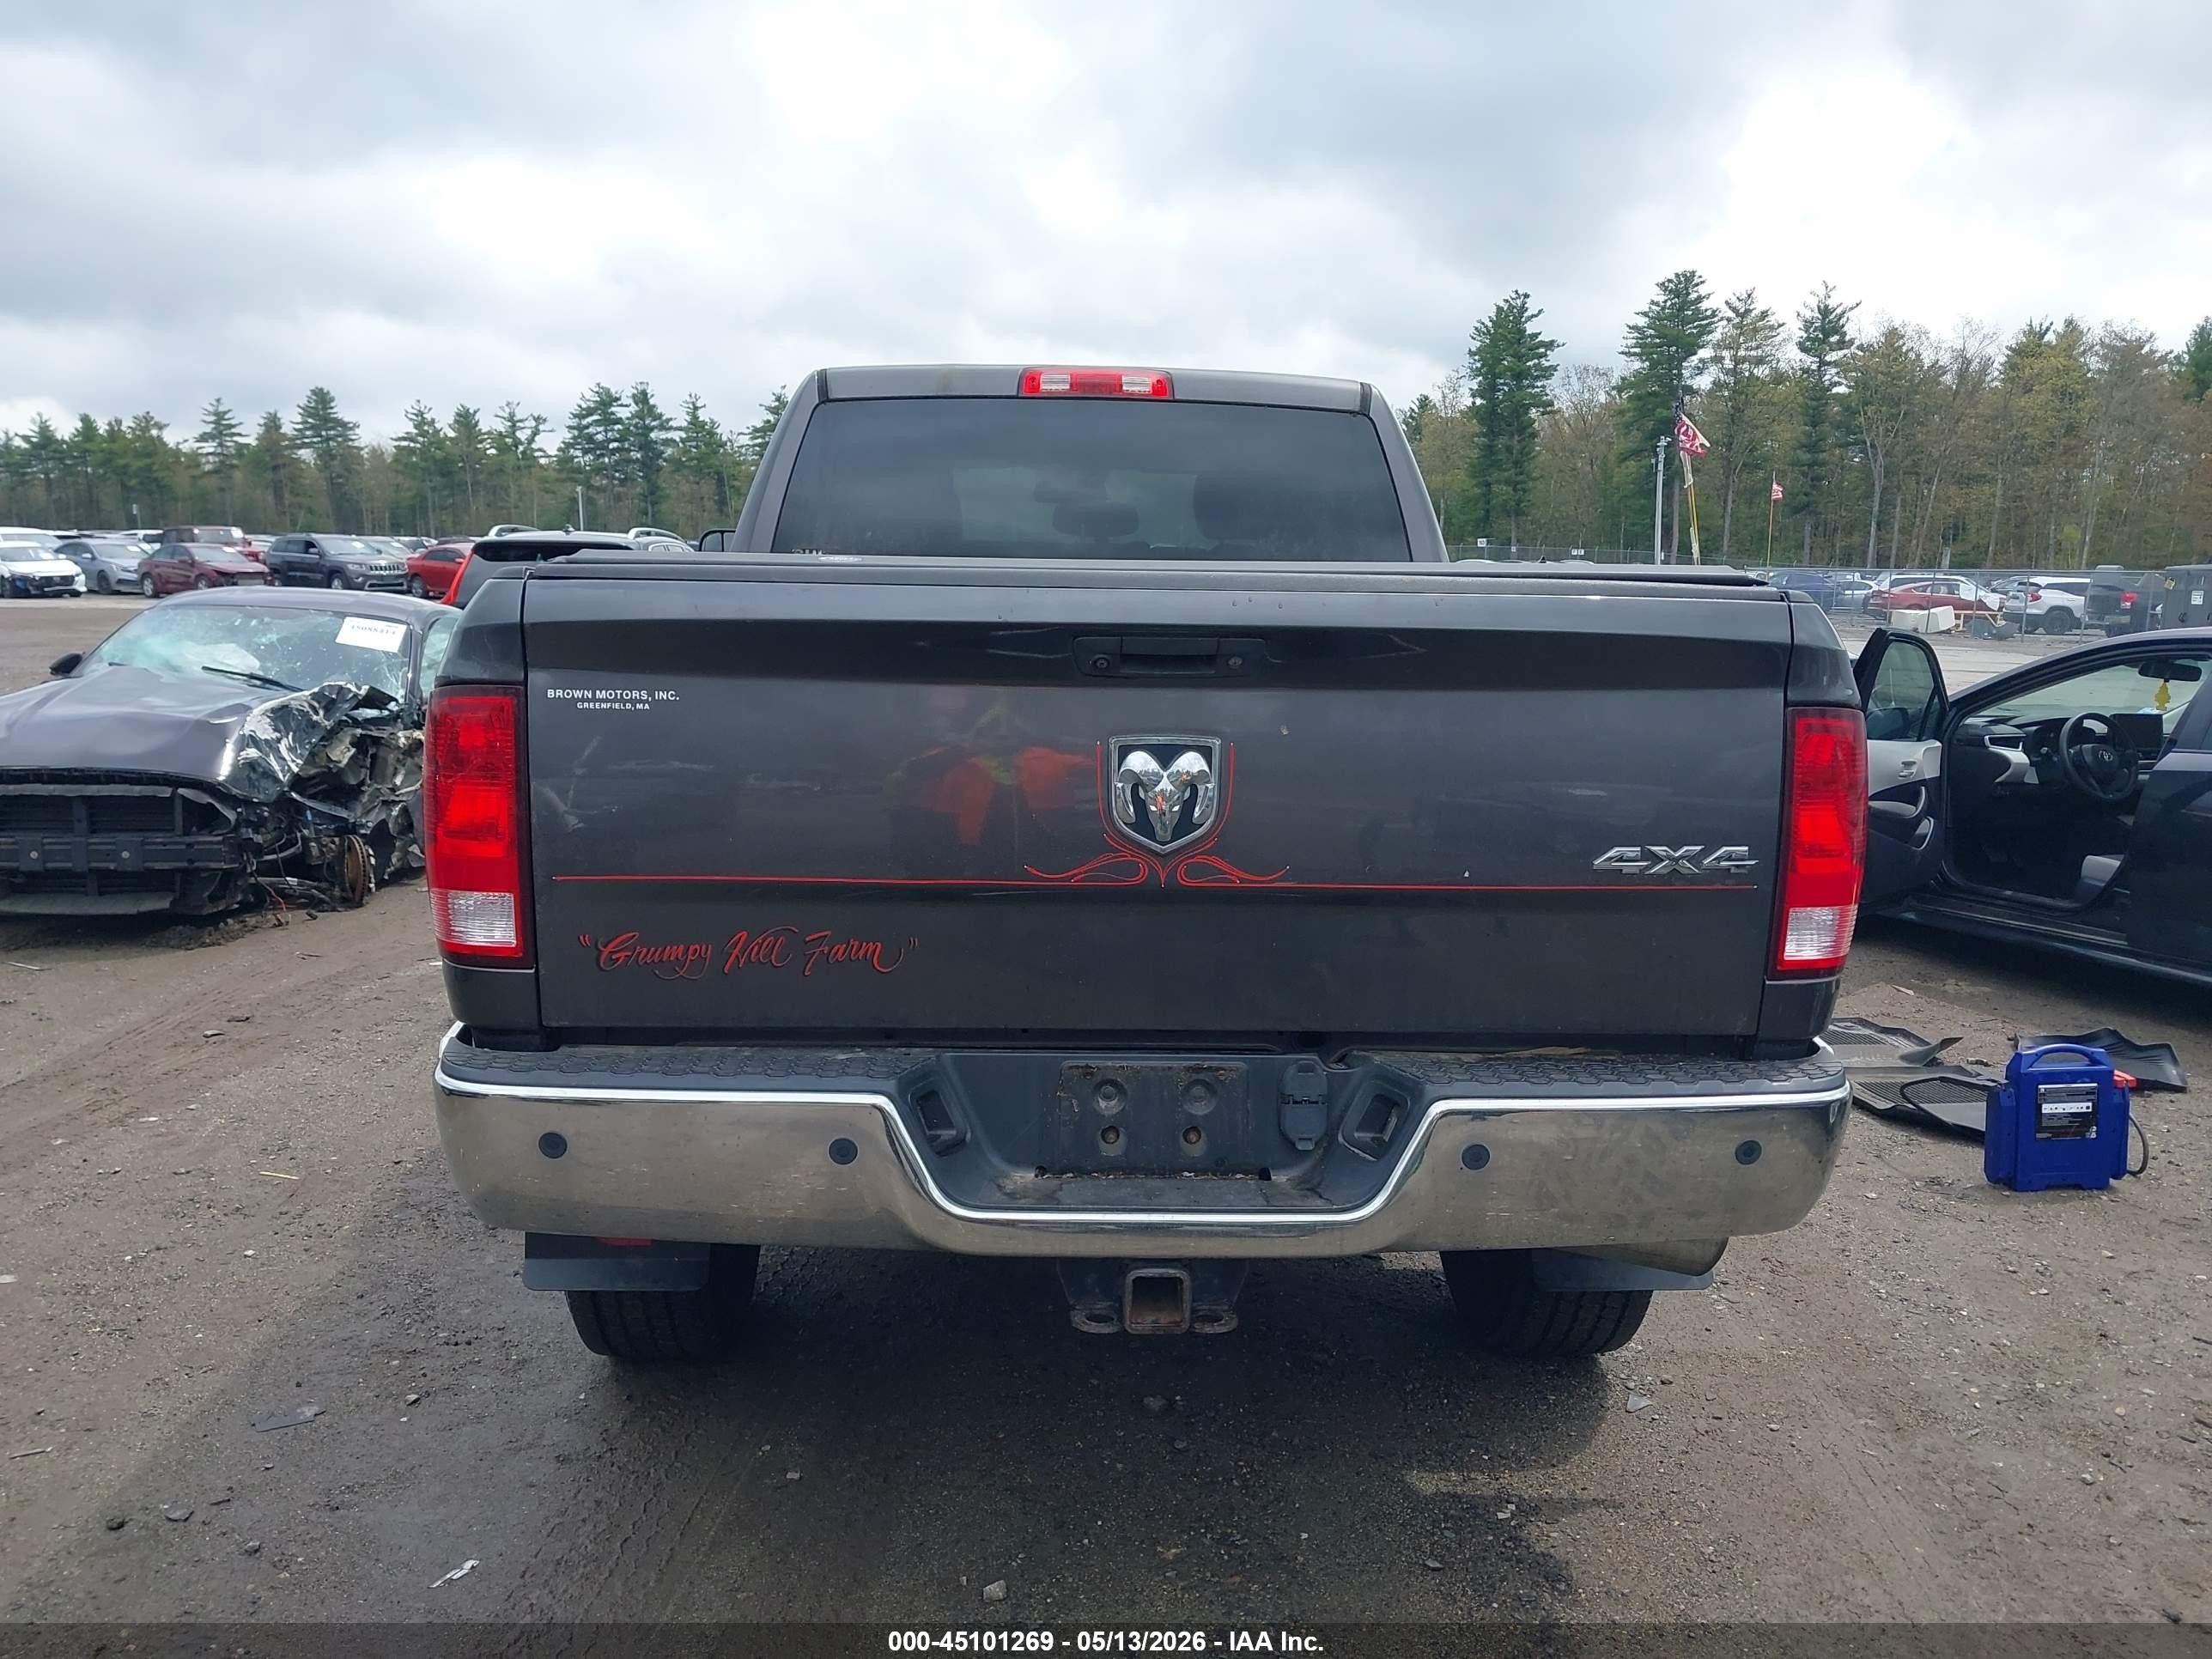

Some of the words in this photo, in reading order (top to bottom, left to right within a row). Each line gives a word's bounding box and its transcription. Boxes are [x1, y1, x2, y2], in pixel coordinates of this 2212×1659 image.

[547, 689, 592, 699] BROWN
[595, 690, 652, 702] MOTORS,
[654, 690, 680, 701] INC.
[576, 702, 635, 711] GREENFIELD,
[635, 702, 650, 711] MA
[1592, 845, 1759, 874] 4X4
[722, 926, 799, 974] Hill
